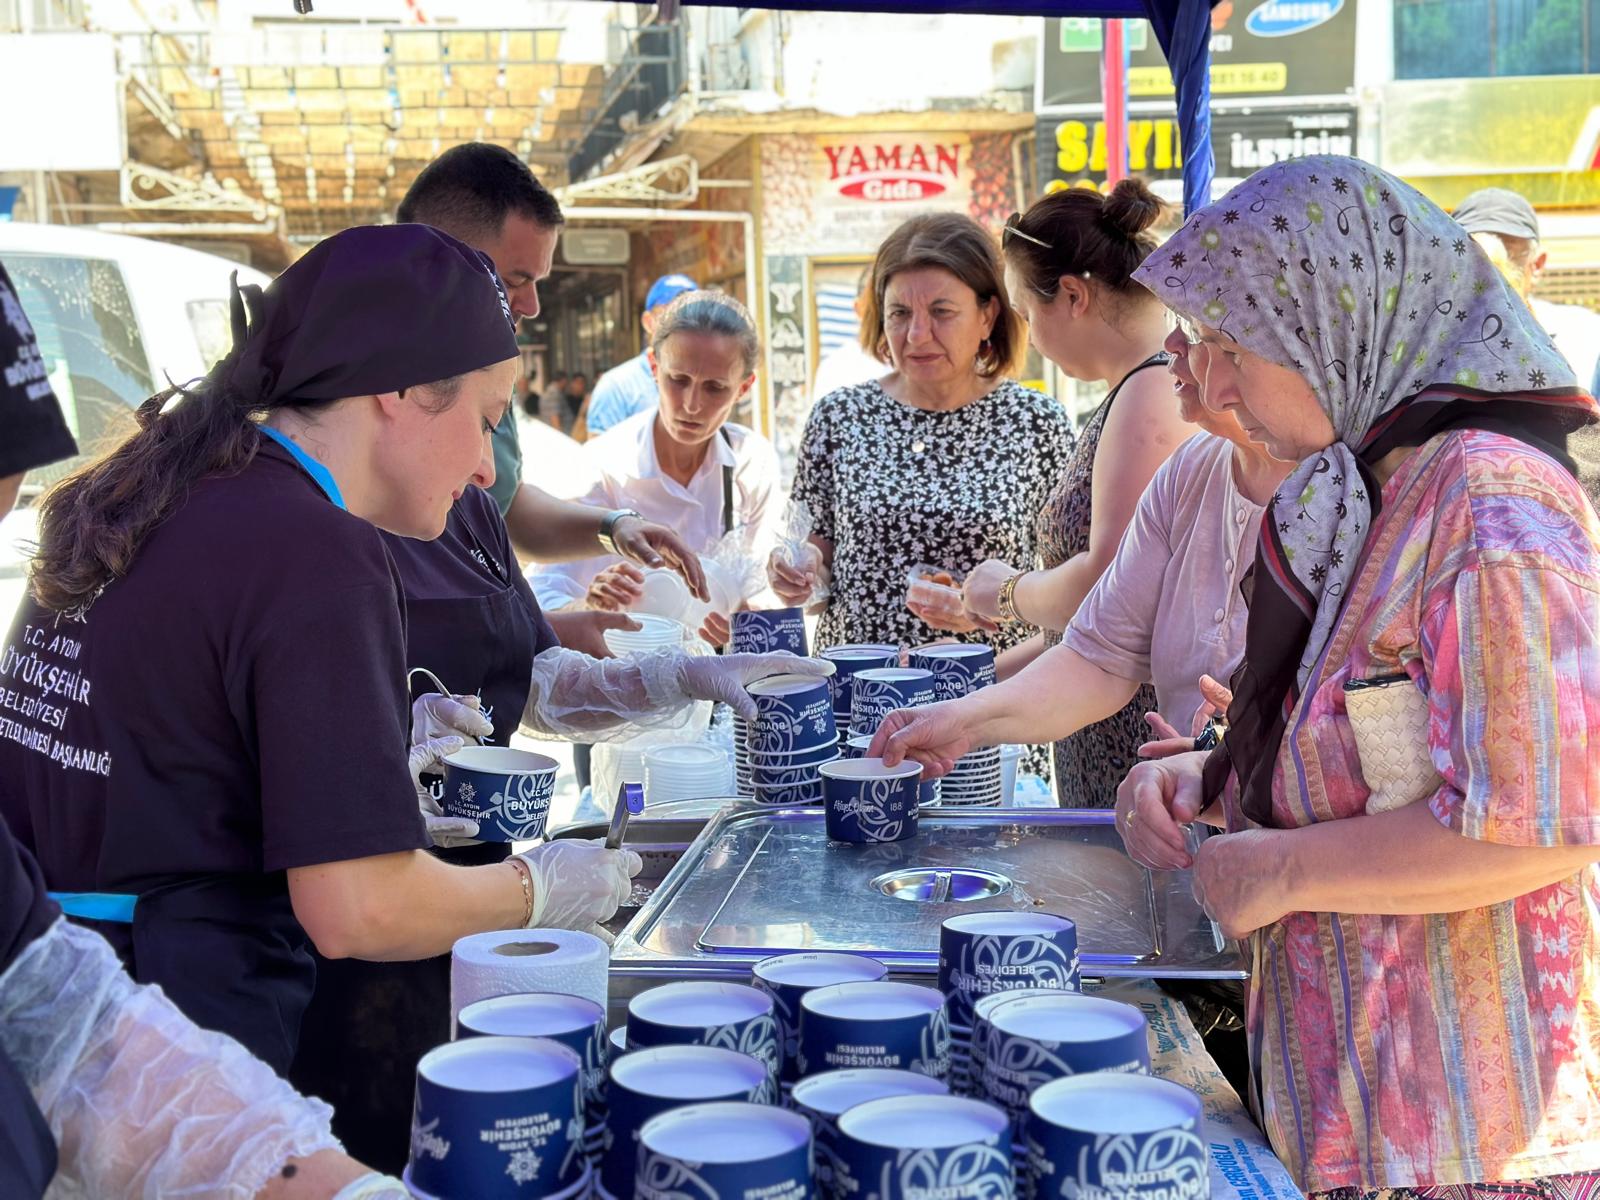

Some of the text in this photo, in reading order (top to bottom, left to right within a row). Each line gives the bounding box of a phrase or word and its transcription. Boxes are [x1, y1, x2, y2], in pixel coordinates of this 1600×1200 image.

[1055, 119, 1182, 172] SYI
[824, 144, 960, 181] YAMAN
[862, 179, 924, 201] Gıda
[48, 634, 82, 660] AYDIN
[0, 645, 91, 706] ÜYÜKŞEHİR
[447, 803, 491, 820] BÜYÜKŞEHİR
[825, 1051, 900, 1067] BÜYÜKŞEHİR
[480, 1118, 562, 1143] BÜYÜKŞEHİR
[495, 1112, 549, 1129] BELEDİYESİ
